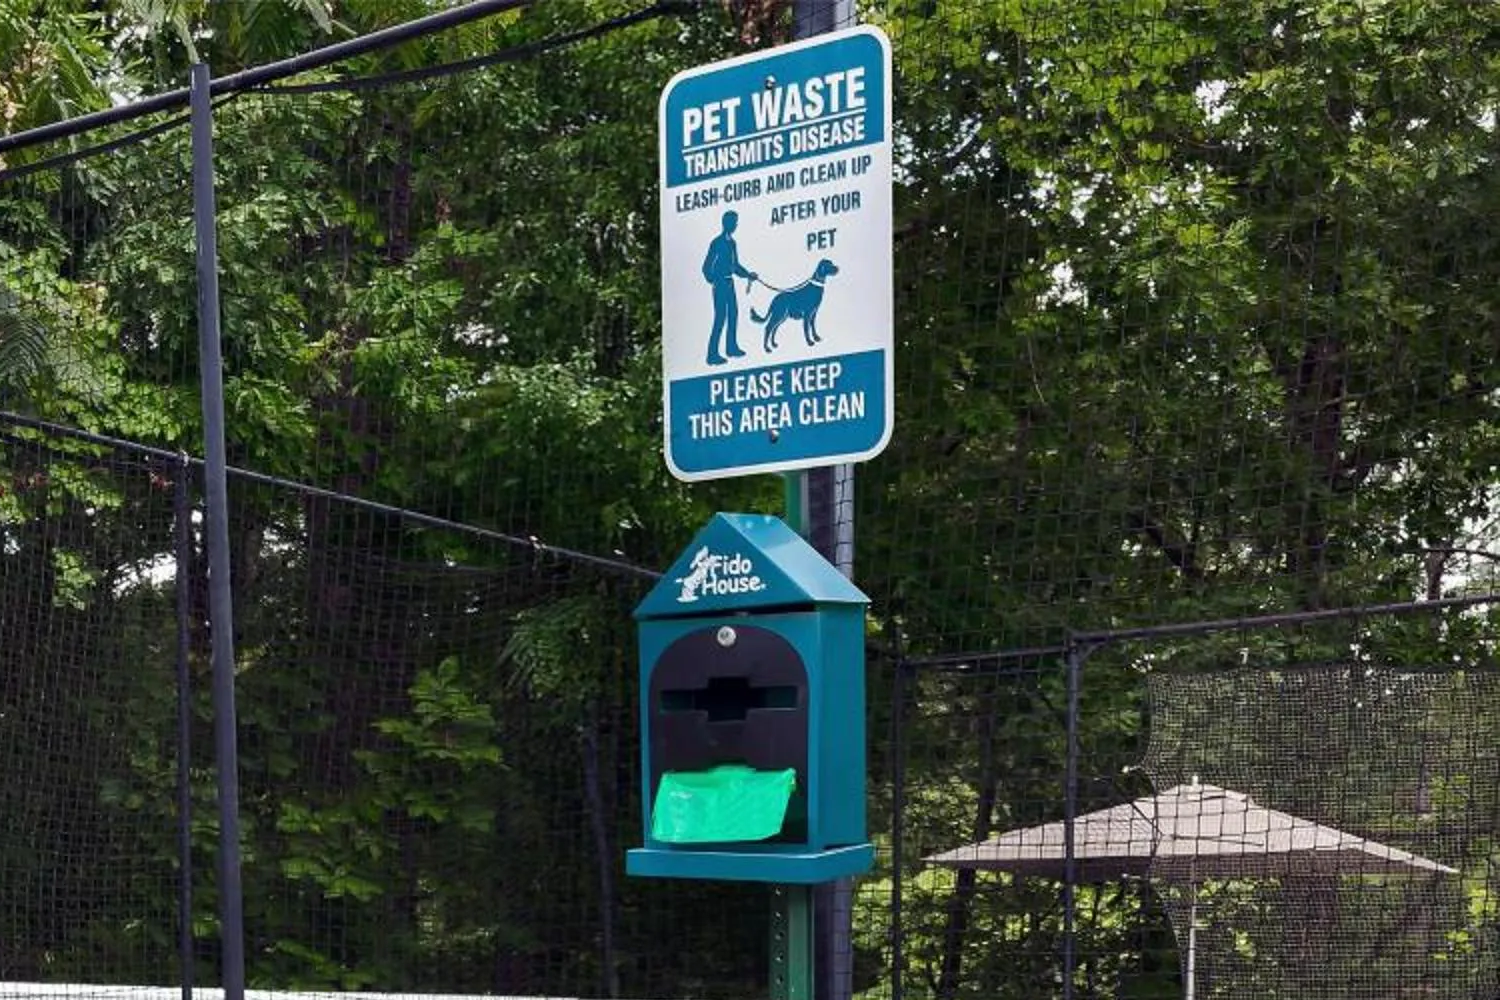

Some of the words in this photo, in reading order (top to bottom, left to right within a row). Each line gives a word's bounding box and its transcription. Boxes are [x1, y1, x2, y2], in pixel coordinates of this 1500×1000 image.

[682, 97, 741, 147] PET
[752, 66, 866, 130] WASTE
[683, 133, 784, 178] TRANSMITS
[790, 115, 866, 155] DISEASE
[676, 178, 761, 213] LEASH-CURB
[767, 171, 795, 194] AND
[800, 159, 847, 187] CLEAN
[852, 155, 872, 175] UP
[770, 199, 816, 226] AFTER
[821, 191, 861, 213] YOUR
[806, 228, 837, 252] PET
[710, 369, 784, 405] PLEASE
[791, 362, 842, 395] KEEP
[688, 411, 733, 440] THIS
[739, 401, 792, 433] AREA
[799, 391, 865, 425] CLEAN
[709, 553, 752, 575] Fido
